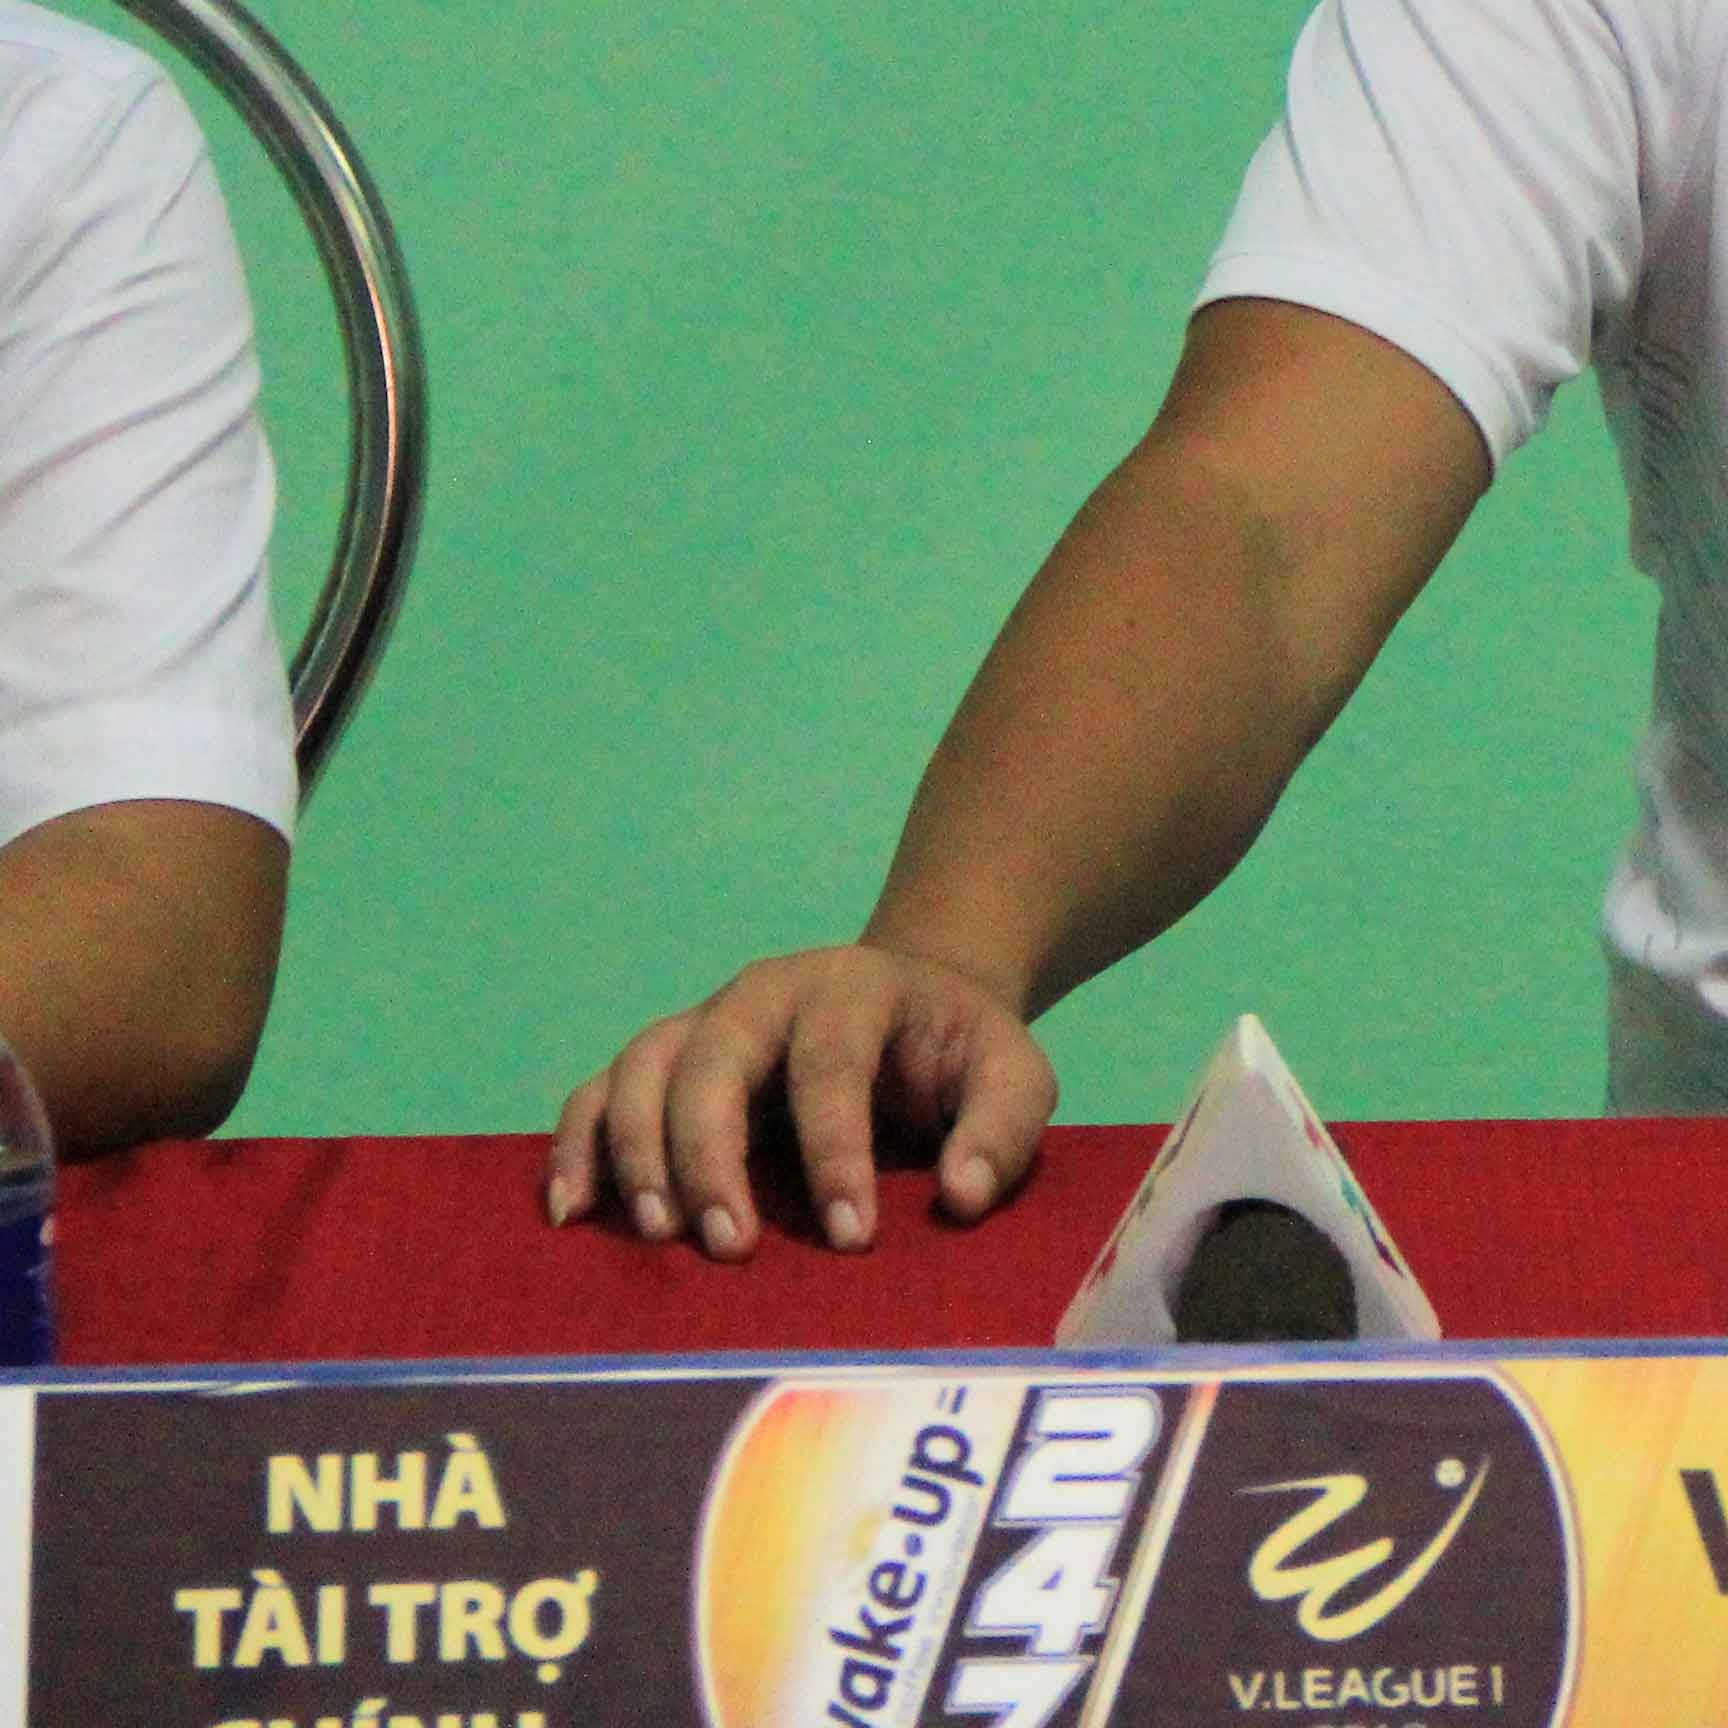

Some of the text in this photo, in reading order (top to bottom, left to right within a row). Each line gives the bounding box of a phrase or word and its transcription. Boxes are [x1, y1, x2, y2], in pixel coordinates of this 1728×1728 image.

[268, 1433, 506, 1532] NHÀ
[175, 1569, 598, 1683] TÀI TRỢ
[1230, 1665, 1479, 1710] V.LEAGUE
